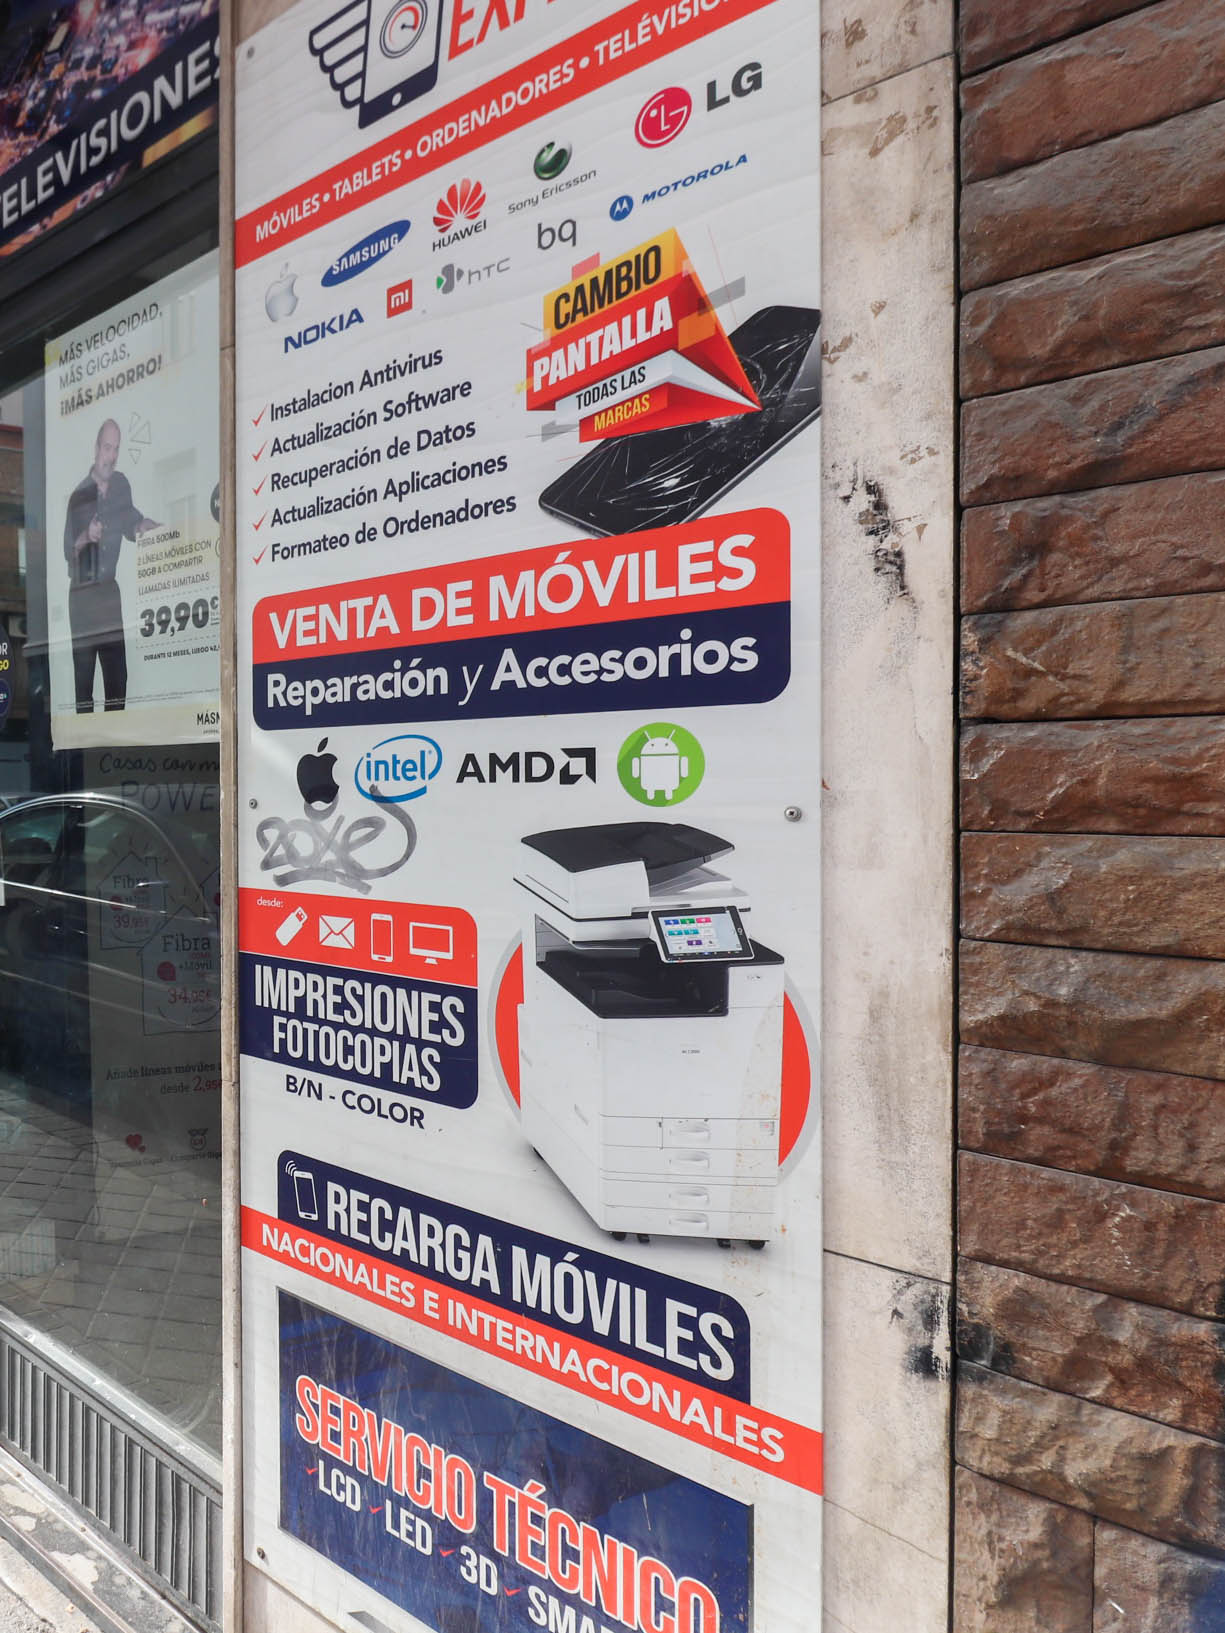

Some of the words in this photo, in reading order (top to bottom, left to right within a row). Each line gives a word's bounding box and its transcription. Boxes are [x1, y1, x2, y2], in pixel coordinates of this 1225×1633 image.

[707, 61, 763, 112] LG
[255, 192, 321, 242] MÓVILES
[333, 150, 401, 201] TABLETS
[417, 58, 575, 158] ORDENADORES
[508, 194, 539, 214] Sony
[542, 169, 597, 199] Ericsson
[642, 154, 749, 204] MOTOROLA
[332, 233, 399, 276] SAMSUNG
[432, 220, 487, 251] HUAWEI
[538, 219, 577, 250] bq
[554, 245, 662, 330] CAMBIO
[59, 341, 84, 367] MÁS
[284, 308, 365, 353] NOKIA
[533, 296, 673, 393] PANTALLA
[60, 365, 84, 391] MÁS
[86, 345, 131, 378] GIGAS,
[96, 354, 162, 401] AHORRO!
[270, 379, 355, 422] Instalacion
[359, 350, 444, 392] Antivirus
[577, 376, 618, 410] TODAS
[621, 366, 646, 391] LAS
[270, 409, 378, 456] Actualización
[383, 381, 473, 422] Software
[594, 394, 651, 432] MARCAS
[271, 442, 381, 492] Recuperación
[387, 437, 411, 459] de
[417, 419, 476, 452] Datos
[270, 481, 378, 528] Actualización
[383, 454, 508, 508] Aplicaciones
[164, 544, 194, 559] MÓVILES
[194, 540, 212, 551] CON
[271, 531, 350, 562] Formateo
[355, 523, 378, 545] de
[383, 495, 517, 538] Ordenadores
[138, 580, 171, 596] LLAMADAS
[172, 571, 210, 588] ILIMITADAS
[163, 555, 204, 573] COMPARTIR
[269, 597, 401, 650] VENTA
[412, 580, 474, 632] DE
[489, 534, 757, 622] MÓVILES
[267, 658, 449, 715] Reparación
[458, 664, 483, 706] y
[490, 628, 759, 691] Accesorios
[366, 749, 428, 783] intel
[456, 752, 555, 784] AMD
[256, 896, 284, 908] desde:
[161, 932, 211, 953] Fibra
[255, 964, 465, 1047] IMPRESIONES
[273, 1015, 441, 1093] FOTOCOPIAS
[286, 1074, 324, 1102] B/N
[342, 1089, 425, 1129] COLOR
[327, 1180, 500, 1294] RECARGA
[511, 1251, 735, 1381] MÓVILES
[262, 1223, 416, 1309] NACIONALES
[424, 1289, 440, 1320] E
[448, 1299, 785, 1464] INTERNACIONALES
[295, 1374, 476, 1535] SERVICIO
[483, 1470, 721, 1633] TÉCNICO
[319, 1459, 362, 1513] LCD
[385, 1506, 433, 1557] LED
[460, 1544, 498, 1597] 3D
[528, 1585, 615, 1633] SMA
